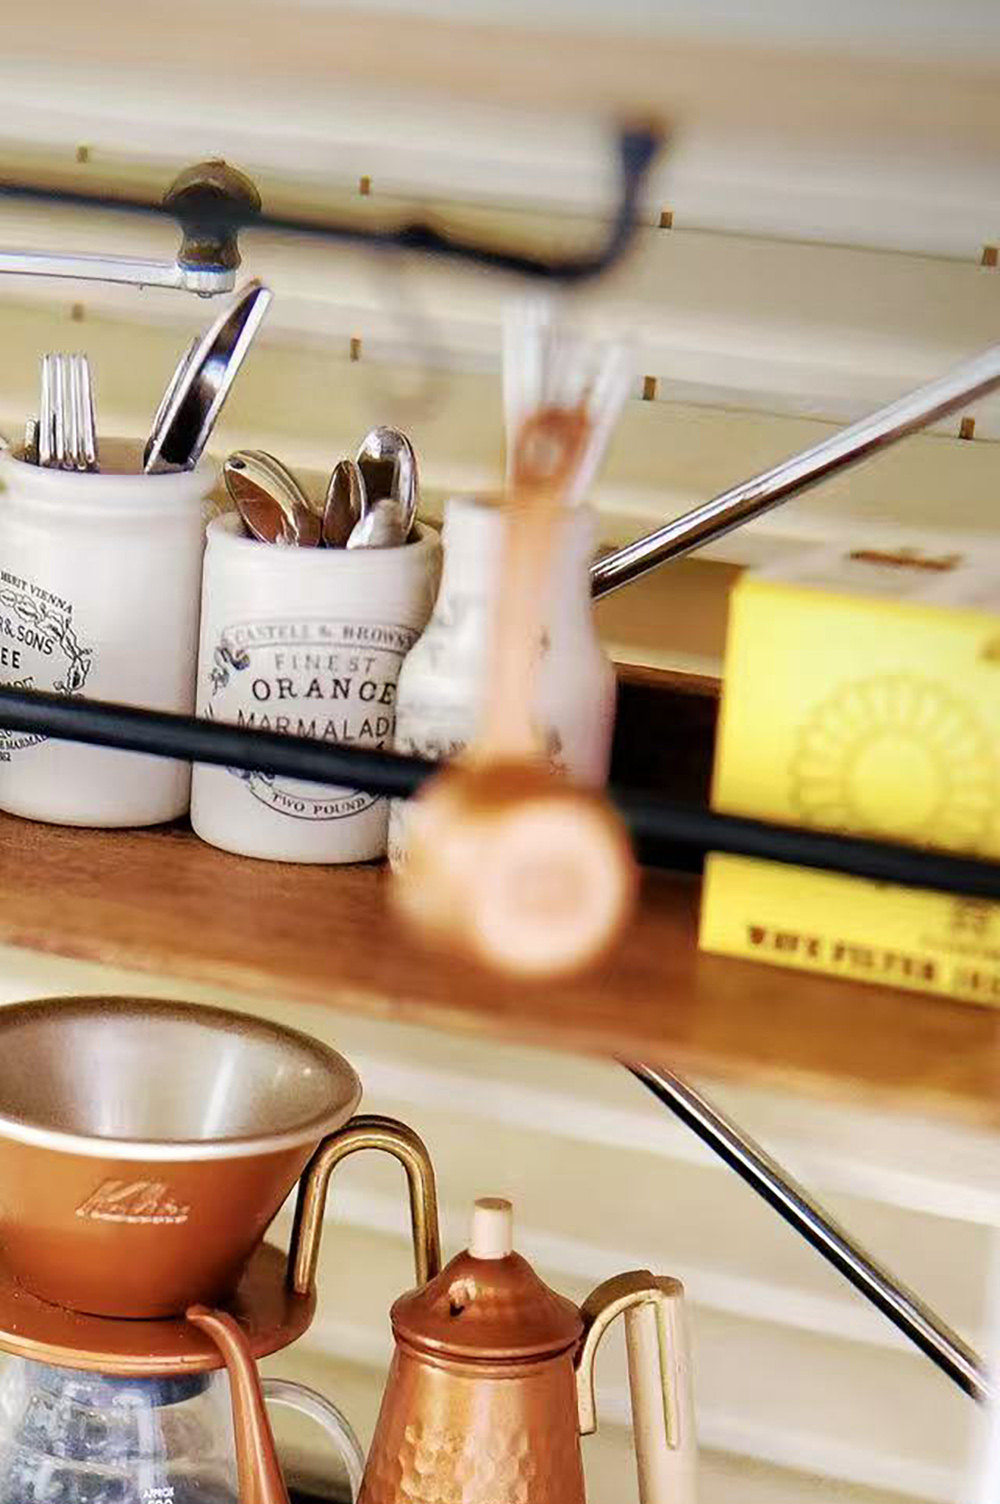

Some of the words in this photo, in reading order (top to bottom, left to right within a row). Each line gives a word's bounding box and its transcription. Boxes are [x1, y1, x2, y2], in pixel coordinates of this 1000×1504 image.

[29, 583, 73, 615] VIENNA
[16, 624, 55, 655] SONS
[274, 654, 378, 674] FINEST
[252, 678, 398, 706] ORANGE
[237, 708, 397, 741] MARMALAD
[272, 793, 306, 813] TWO
[313, 797, 366, 815] POUND
